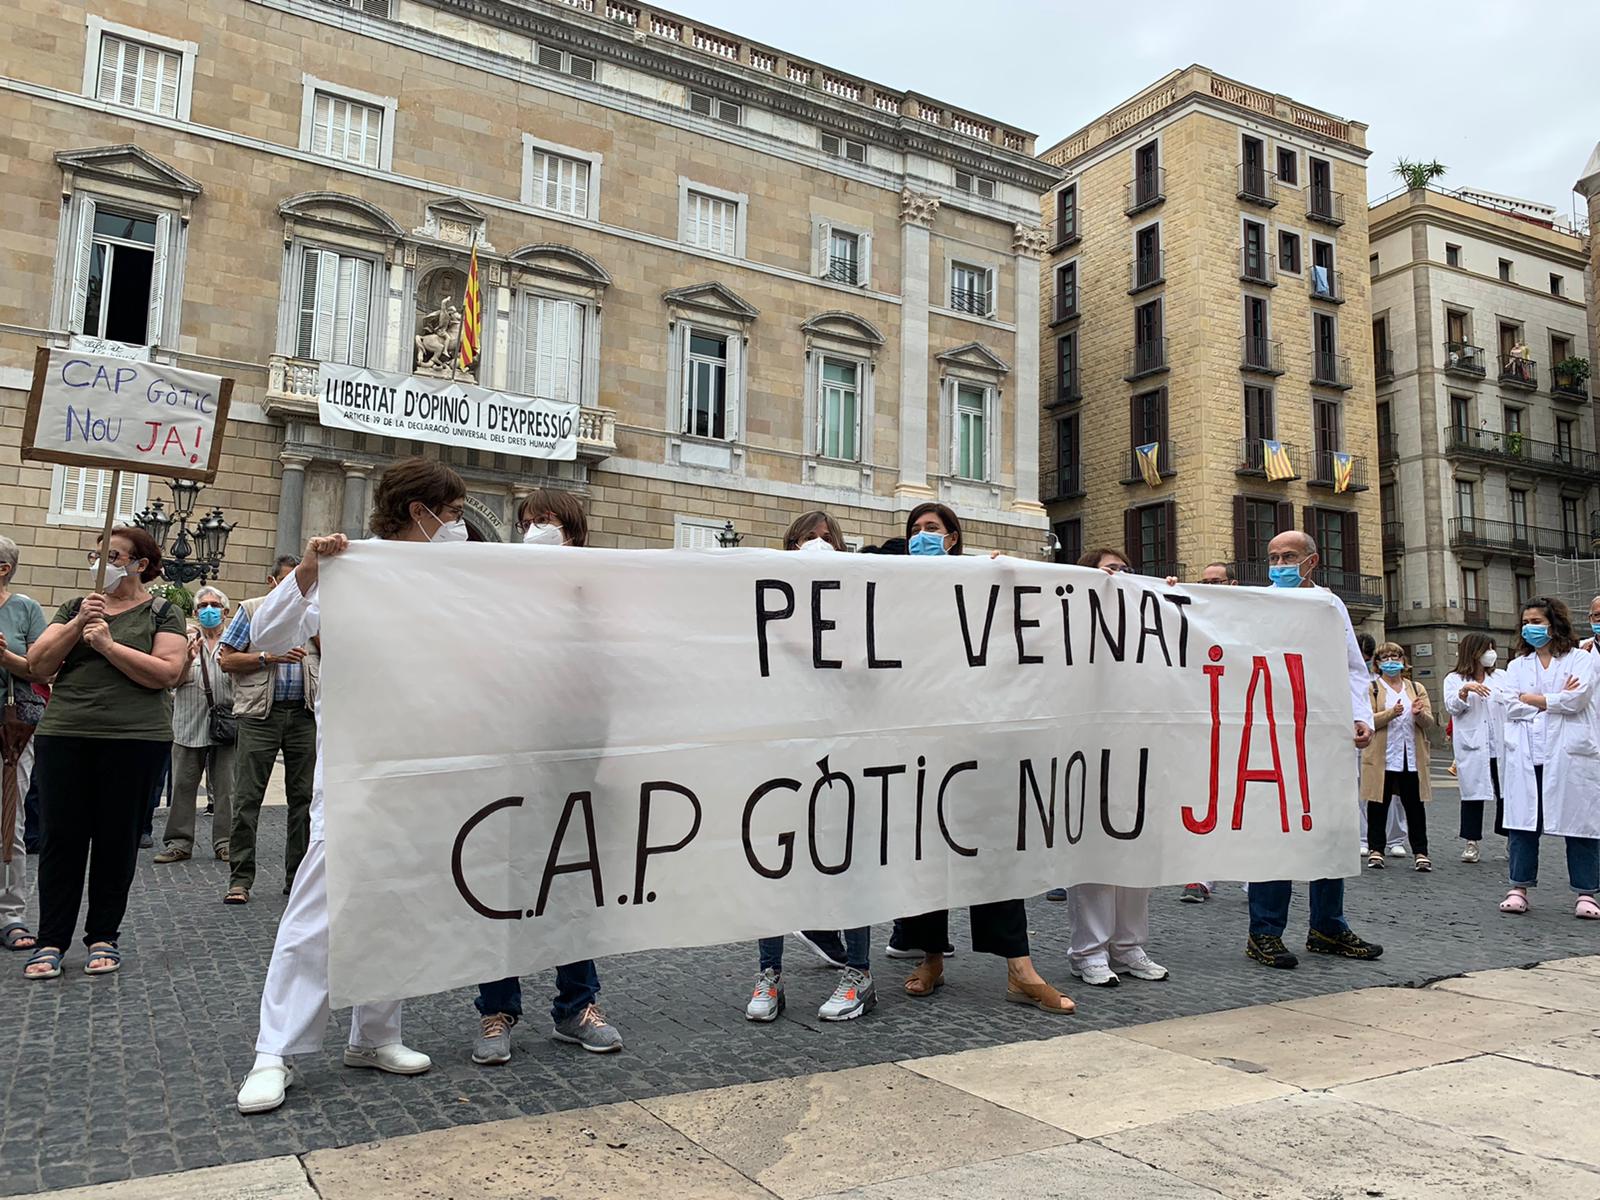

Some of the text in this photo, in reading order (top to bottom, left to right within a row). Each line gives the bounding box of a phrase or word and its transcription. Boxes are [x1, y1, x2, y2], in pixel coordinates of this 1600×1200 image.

[62, 359, 137, 394] CAP
[326, 378, 572, 439] LLIBERTAT D'OPINIÓ I D'EXPRESSIÓ
[136, 421, 202, 464] JA!
[343, 411, 557, 450] ARTICLE 19 DE LA DECLARACIÓ UNIVERSAL DELS DRETS HUMANS
[464, 495, 502, 527] NERALITAT
[755, 579, 1192, 677] PEL VEÏNAT
[1016, 748, 1149, 852] NOU
